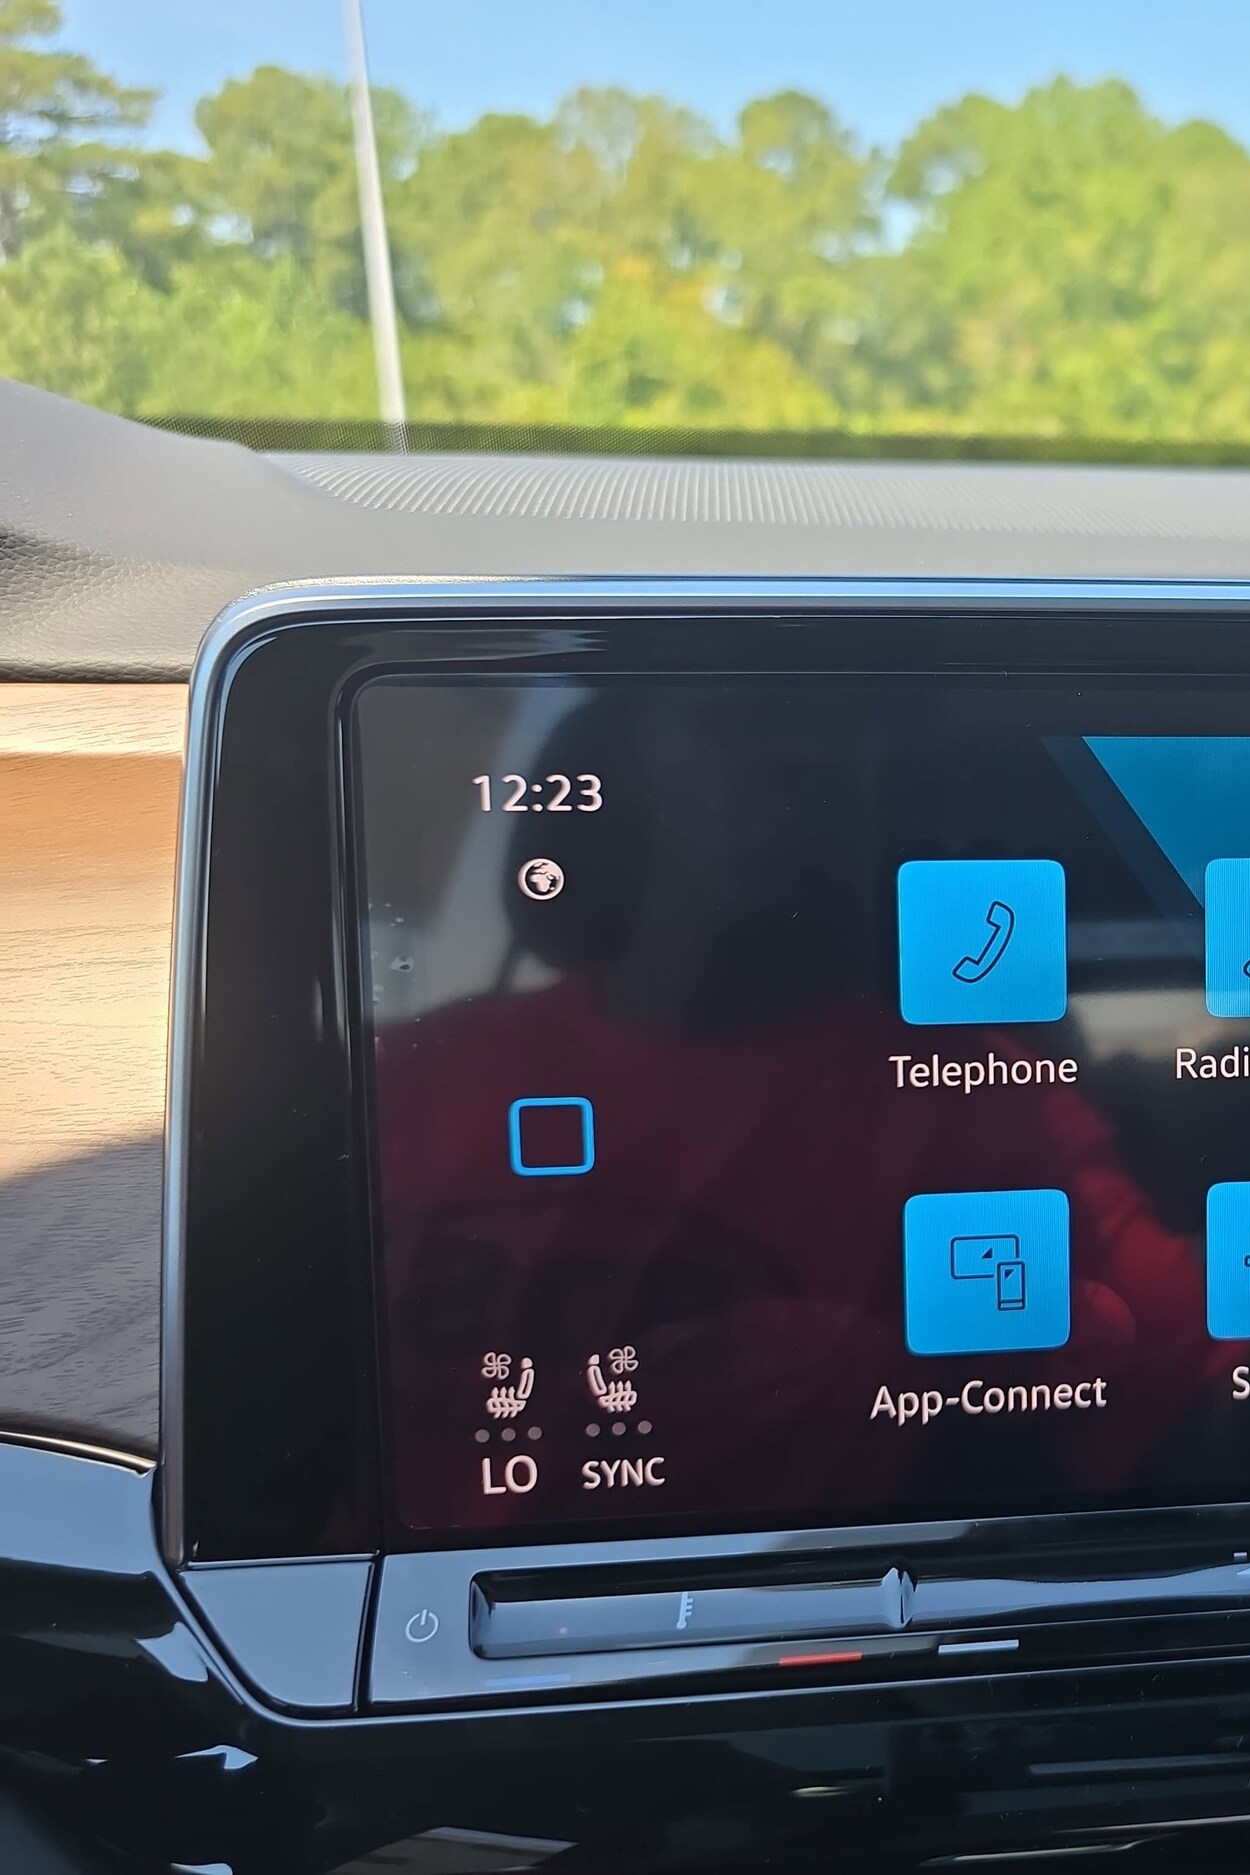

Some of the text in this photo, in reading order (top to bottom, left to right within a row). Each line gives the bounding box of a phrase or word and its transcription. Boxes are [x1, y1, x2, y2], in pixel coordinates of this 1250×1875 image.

[472, 774, 603, 812] 12:23
[889, 1051, 1078, 1094] Telephone
[870, 1377, 1108, 1425] App-Connect
[482, 1454, 538, 1495] LO
[581, 1457, 666, 1490] SYNC
